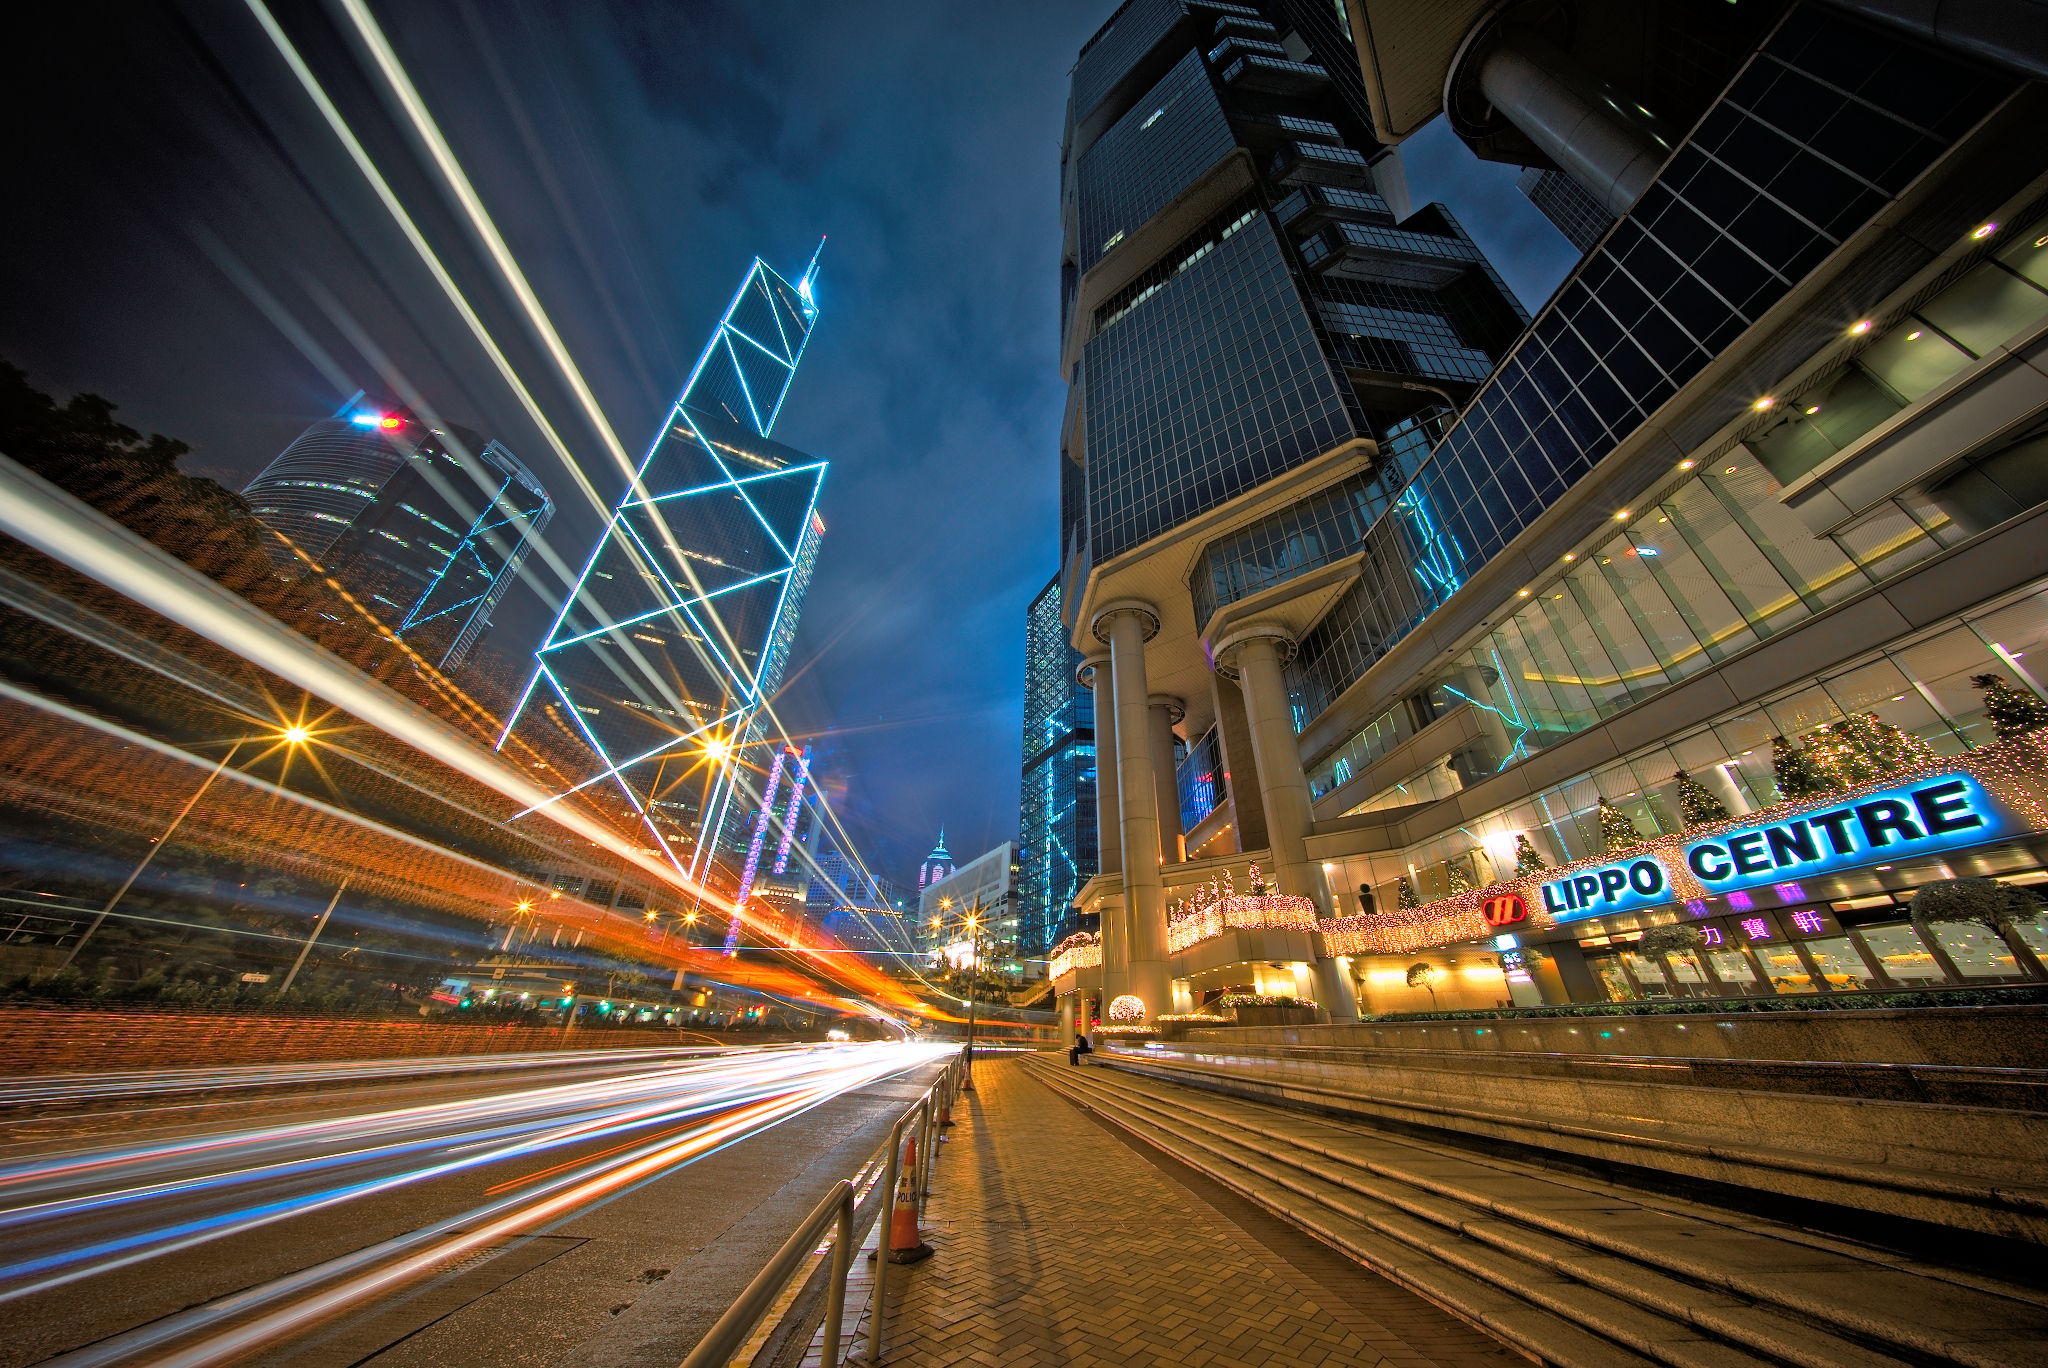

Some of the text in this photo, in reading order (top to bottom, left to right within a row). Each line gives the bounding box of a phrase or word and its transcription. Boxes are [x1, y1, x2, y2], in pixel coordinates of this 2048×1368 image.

[1542, 780, 1985, 914] LIPPO CENTRE
[1699, 909, 1823, 946] 力寶軒
[897, 1191, 917, 1203] POLIC
